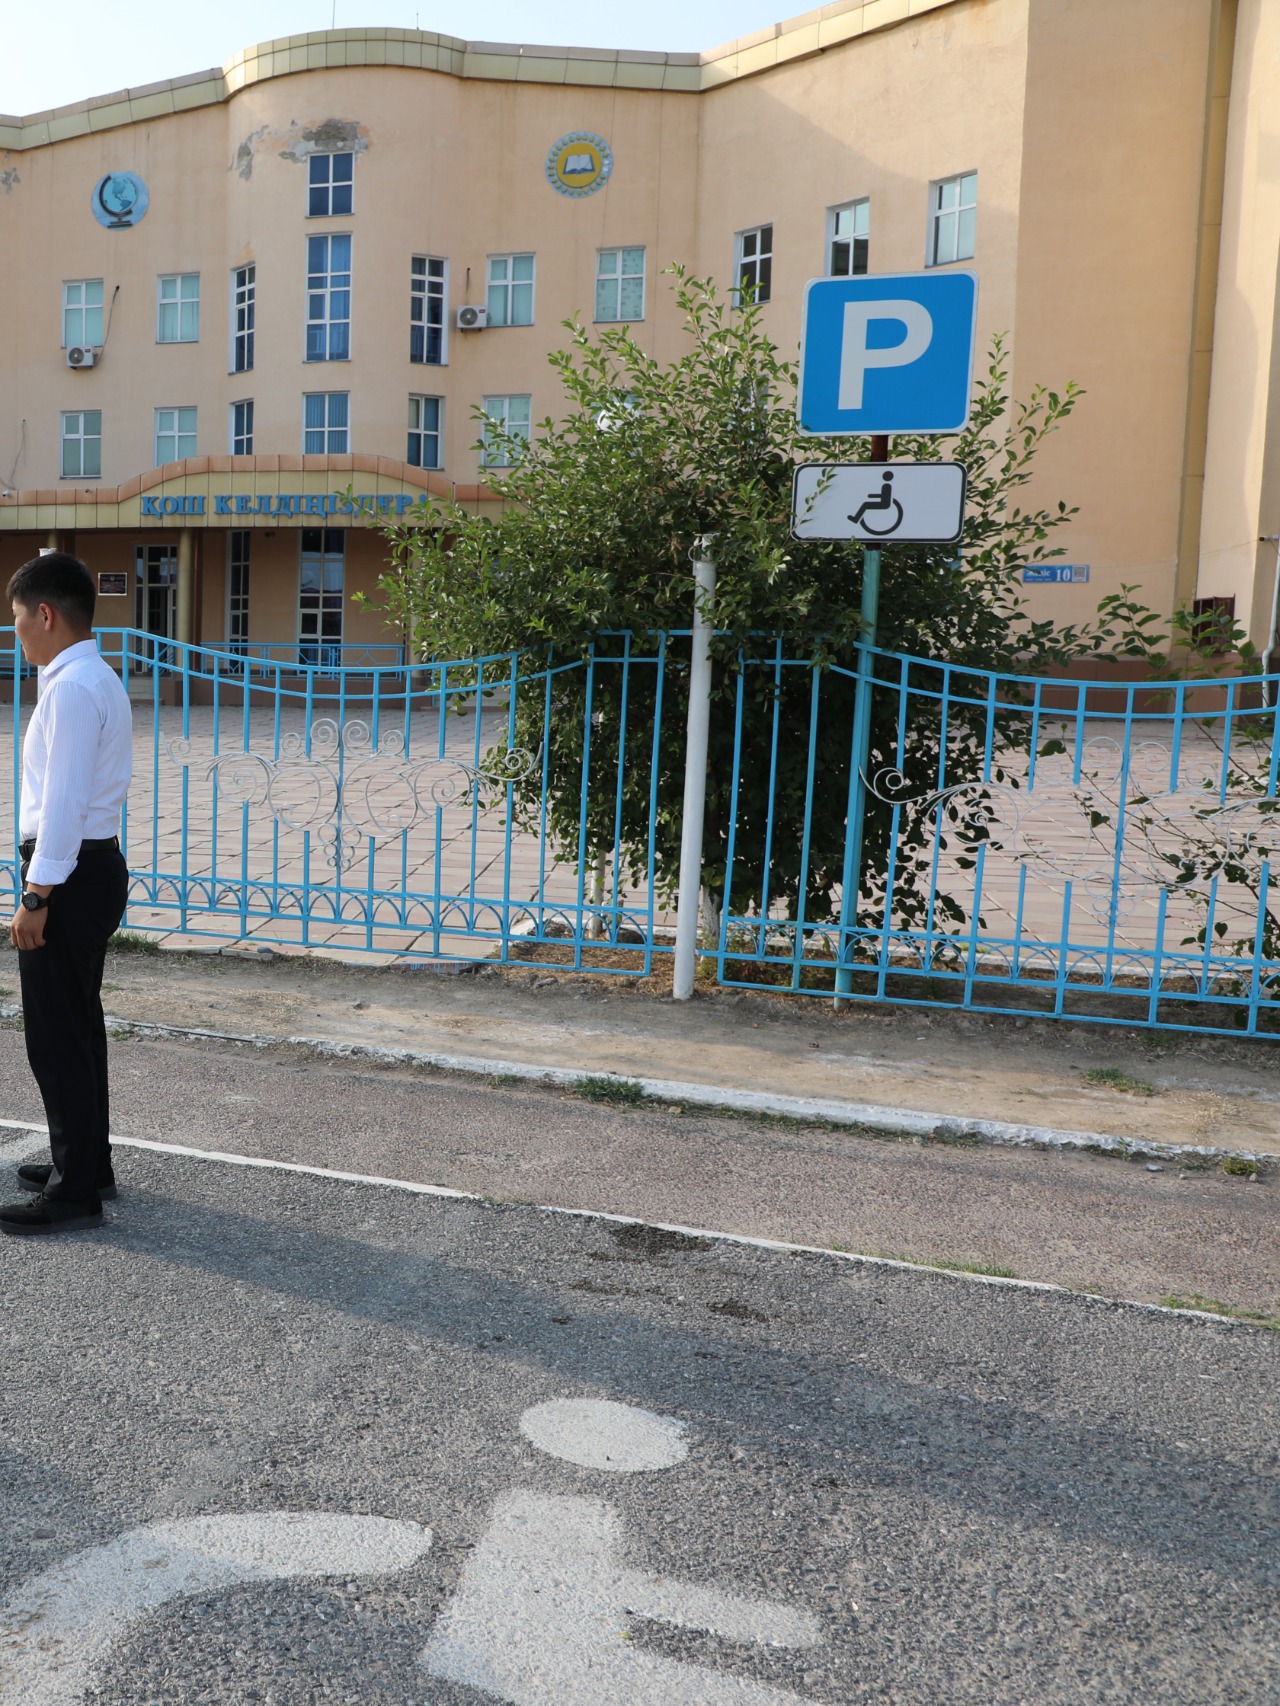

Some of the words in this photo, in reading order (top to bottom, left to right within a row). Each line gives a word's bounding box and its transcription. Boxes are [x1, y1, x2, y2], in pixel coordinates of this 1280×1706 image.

[837, 299, 934, 411] P
[141, 495, 207, 519] ҚОШ
[1056, 567, 1071, 582] 10
